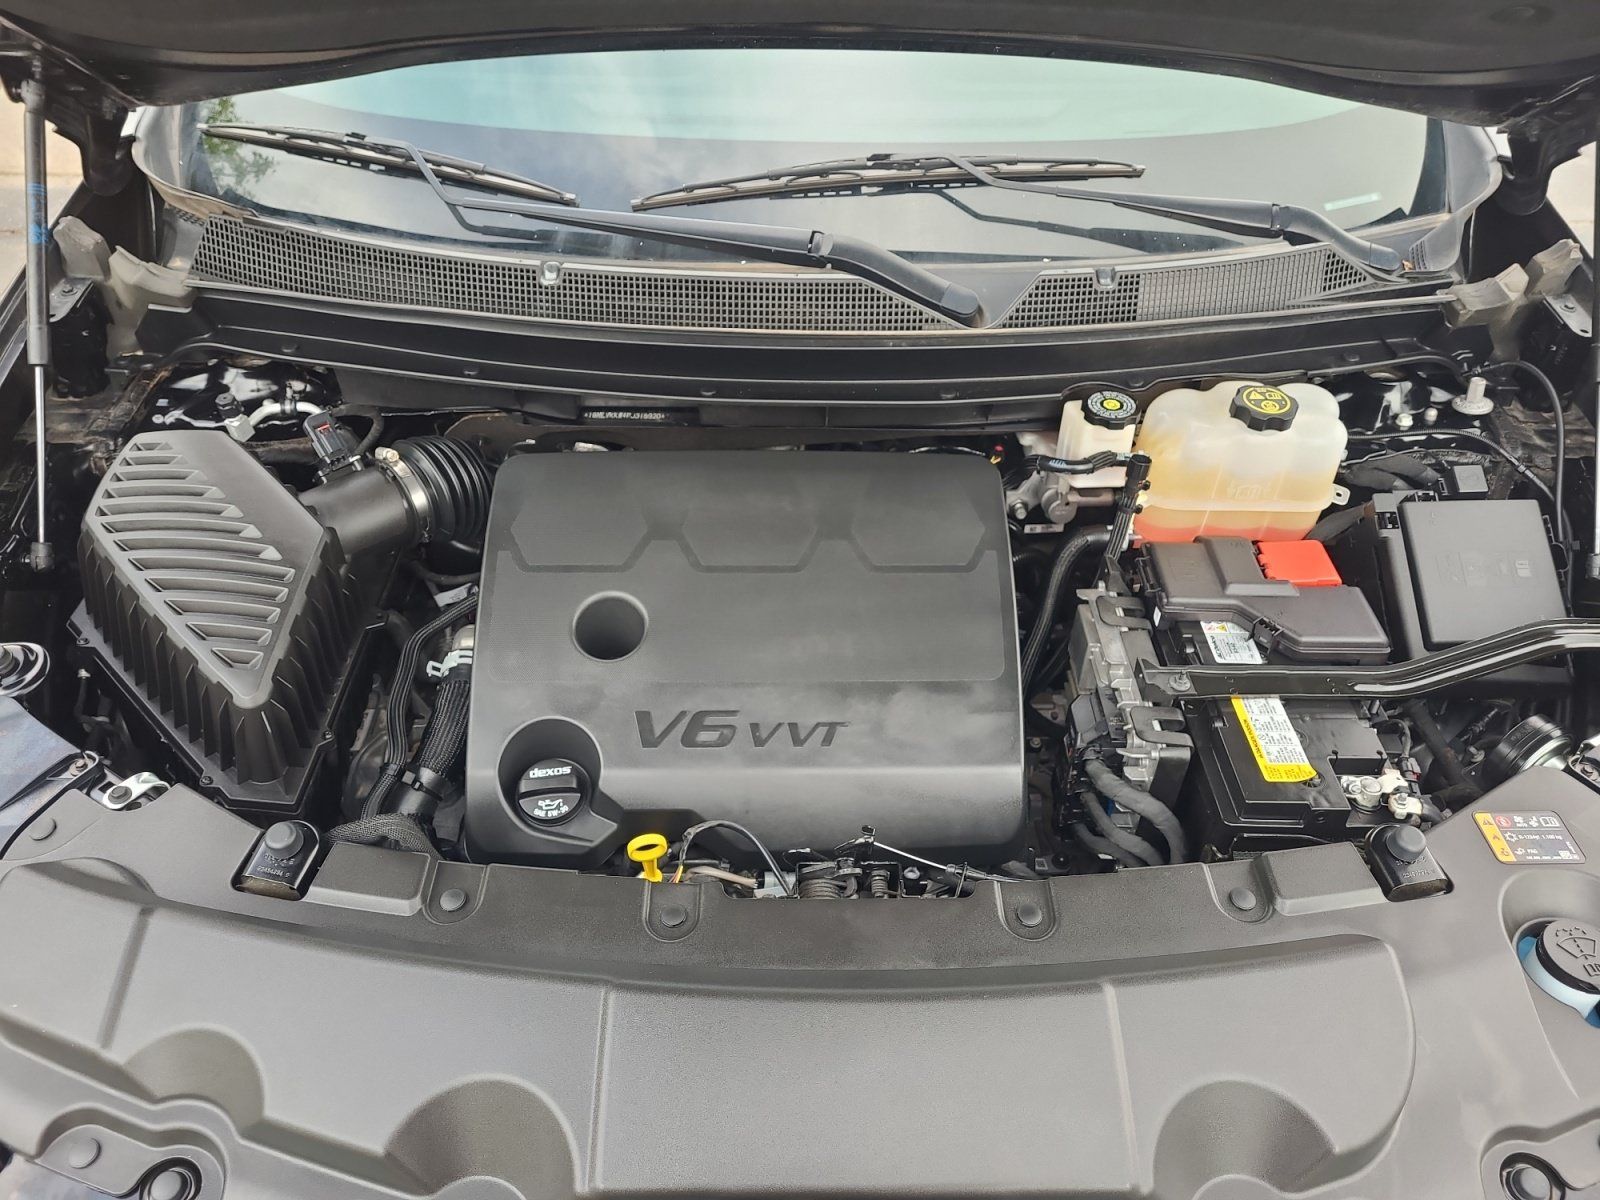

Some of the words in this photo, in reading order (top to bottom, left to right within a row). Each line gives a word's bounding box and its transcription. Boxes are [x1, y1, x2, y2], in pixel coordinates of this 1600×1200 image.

[635, 710, 740, 748] V6
[750, 722, 850, 747] VVT
[529, 766, 572, 778] dexos
